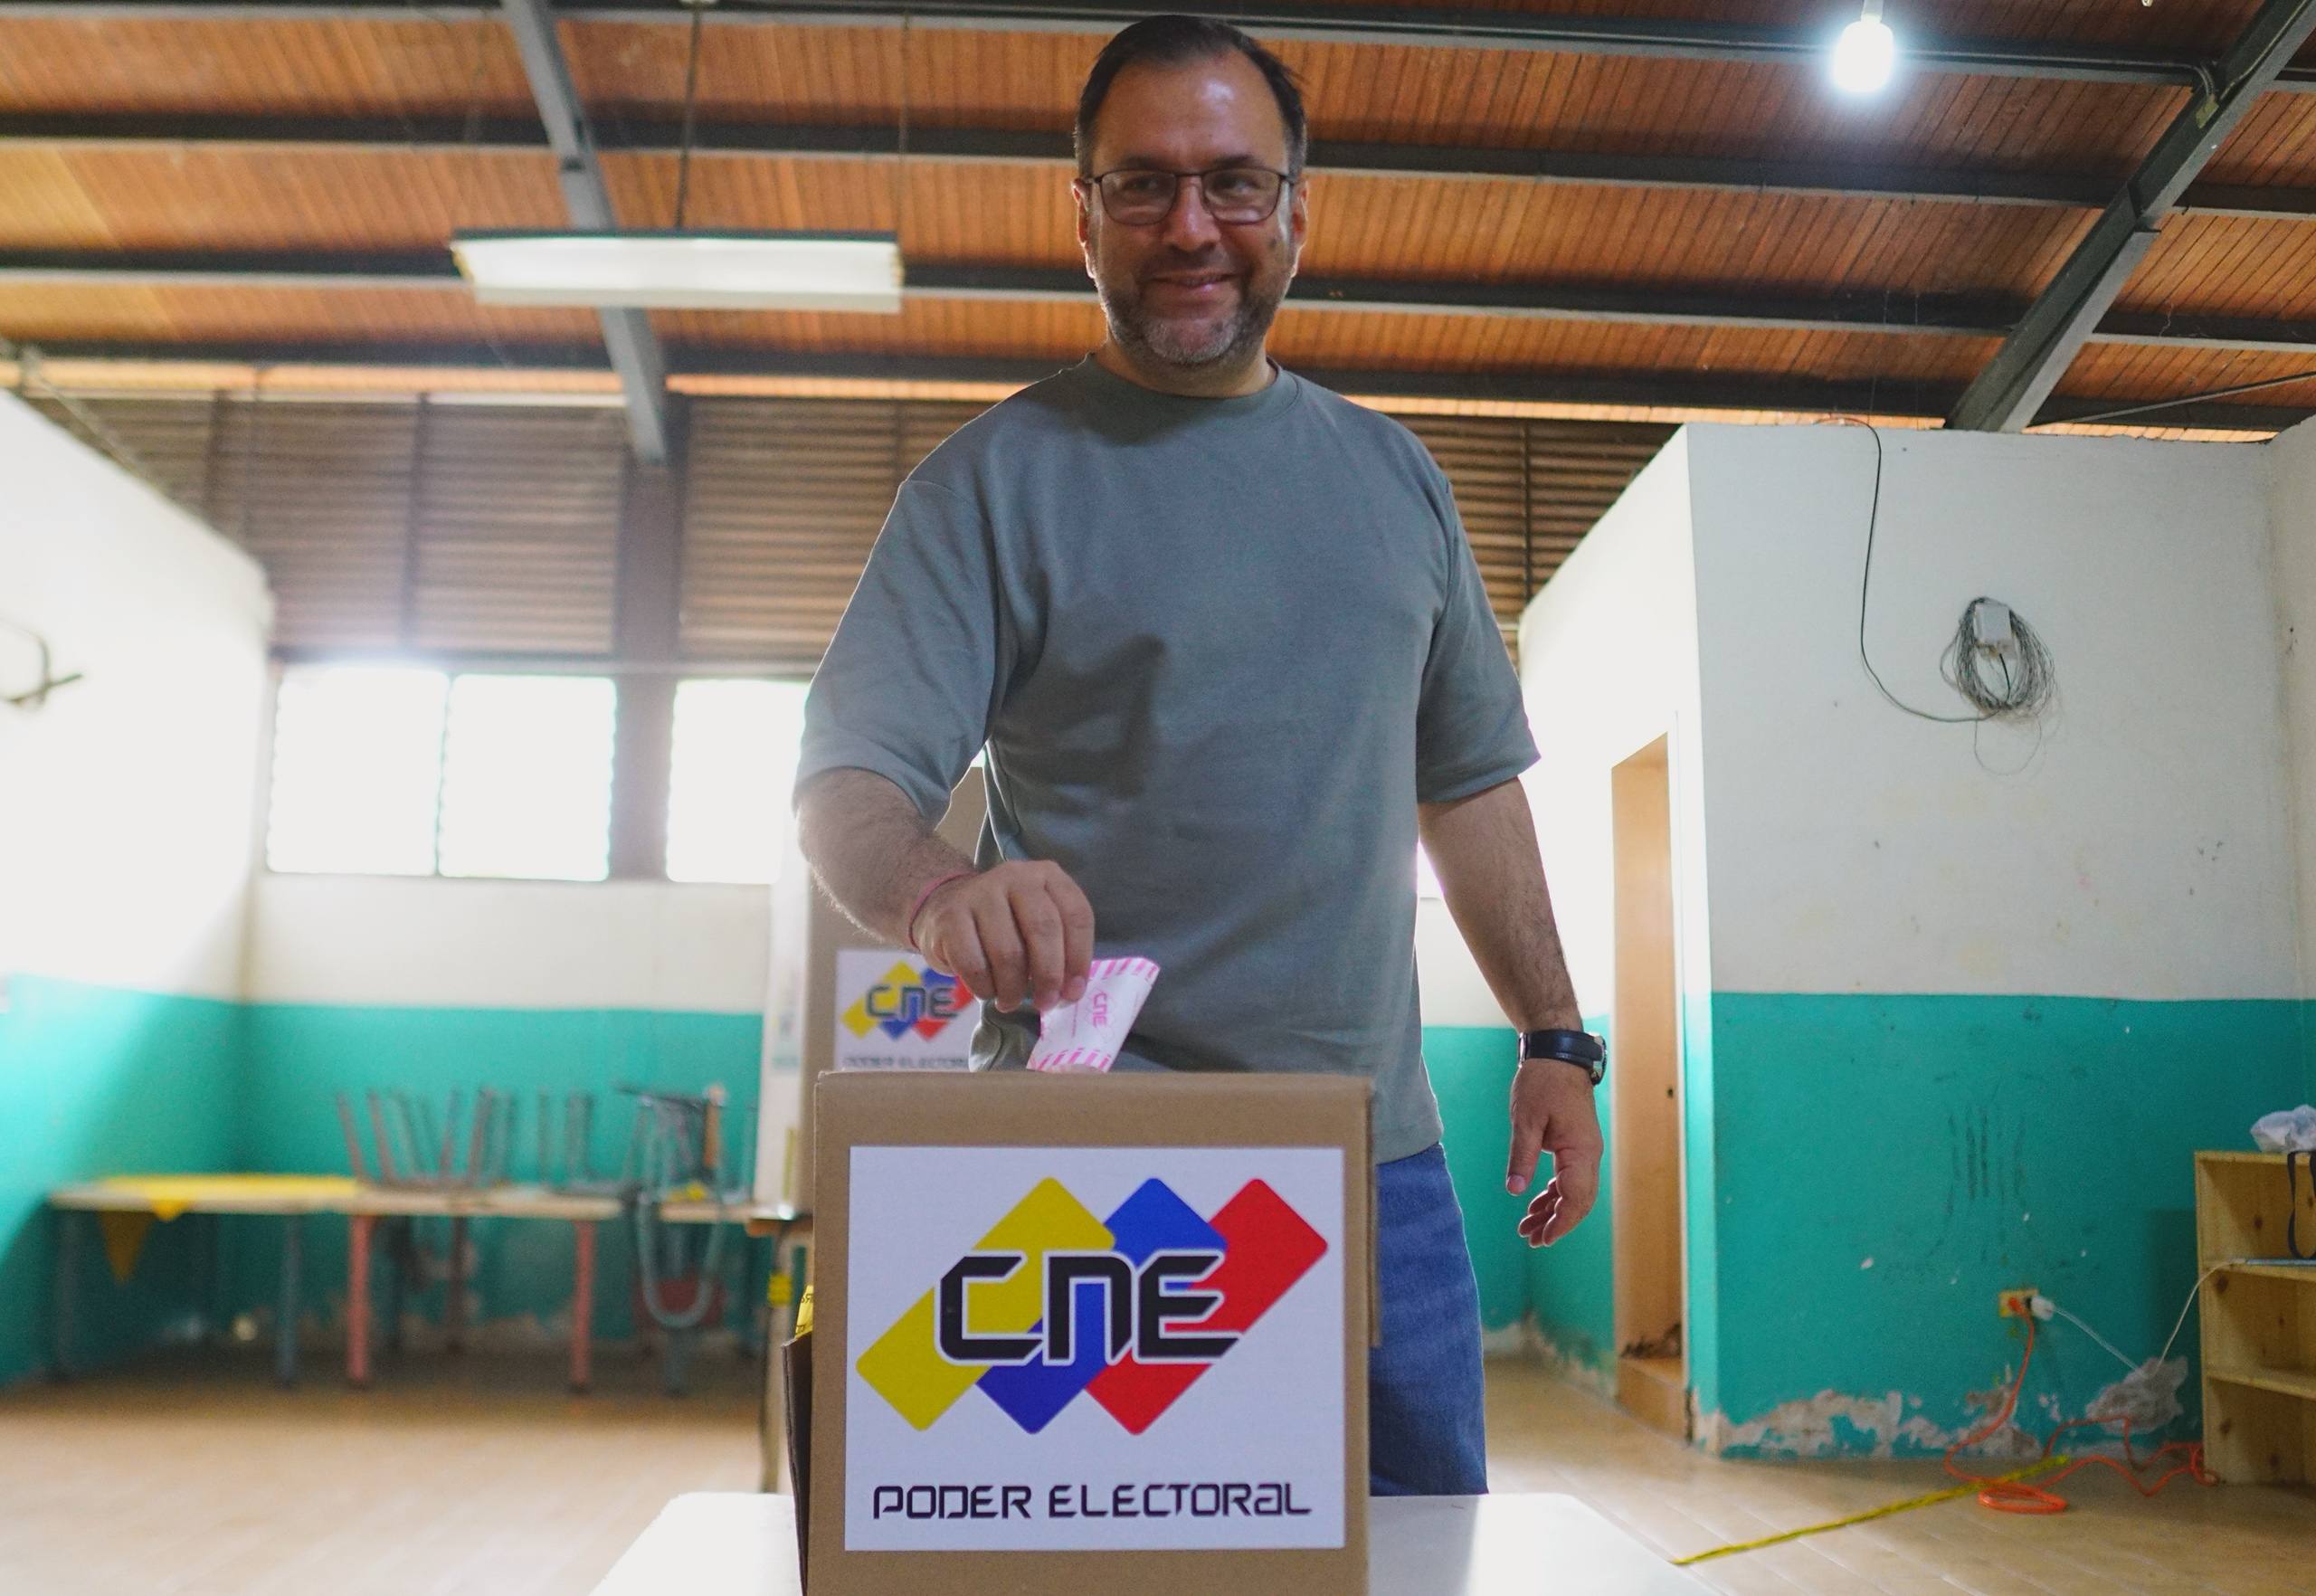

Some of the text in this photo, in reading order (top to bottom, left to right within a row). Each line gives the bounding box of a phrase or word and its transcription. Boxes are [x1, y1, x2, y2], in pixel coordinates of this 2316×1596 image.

[867, 984, 960, 1018] CNE
[1092, 991, 1108, 1028] CNE
[939, 1254, 1241, 1361] CNE
[873, 1482, 1313, 1520] PODER ELECTORAL
